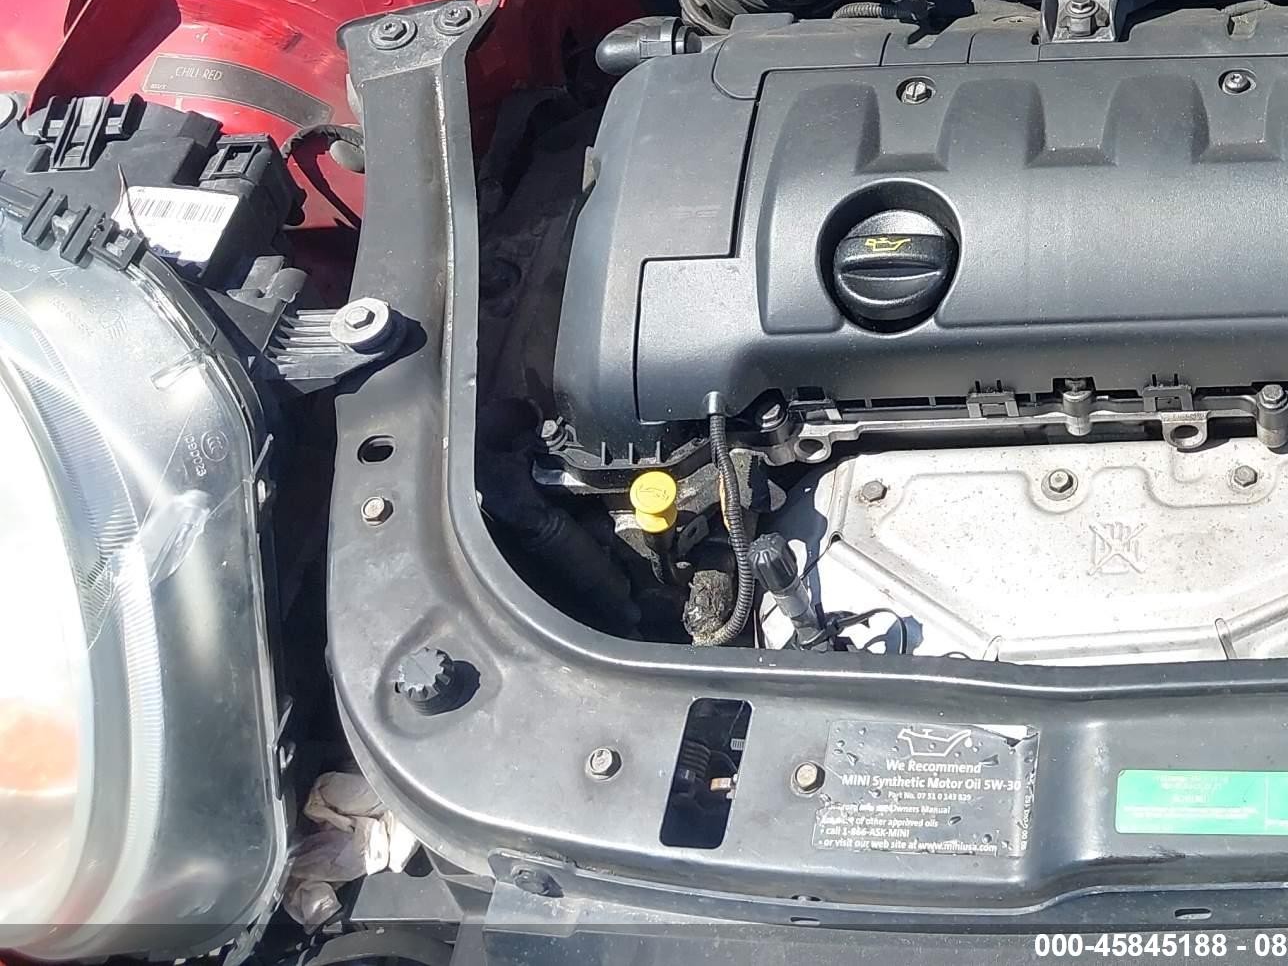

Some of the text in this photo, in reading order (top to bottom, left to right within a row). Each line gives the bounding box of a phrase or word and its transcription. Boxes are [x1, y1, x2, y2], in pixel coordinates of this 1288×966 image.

[203, 69, 223, 81] RED
[886, 759, 982, 773] We Recommend
[841, 775, 1021, 791] MINI Synthetic Motor Oil 5W-30
[920, 805, 951, 815] Manual
[855, 816, 865, 825] of
[865, 816, 886, 826] other
[887, 818, 924, 828] approved
[924, 819, 938, 828] oils
[826, 826, 841, 835] call
[823, 839, 833, 847] or
[835, 838, 853, 847] visit
[854, 840, 870, 848] our
[871, 839, 890, 849] web
[890, 840, 907, 850] site
